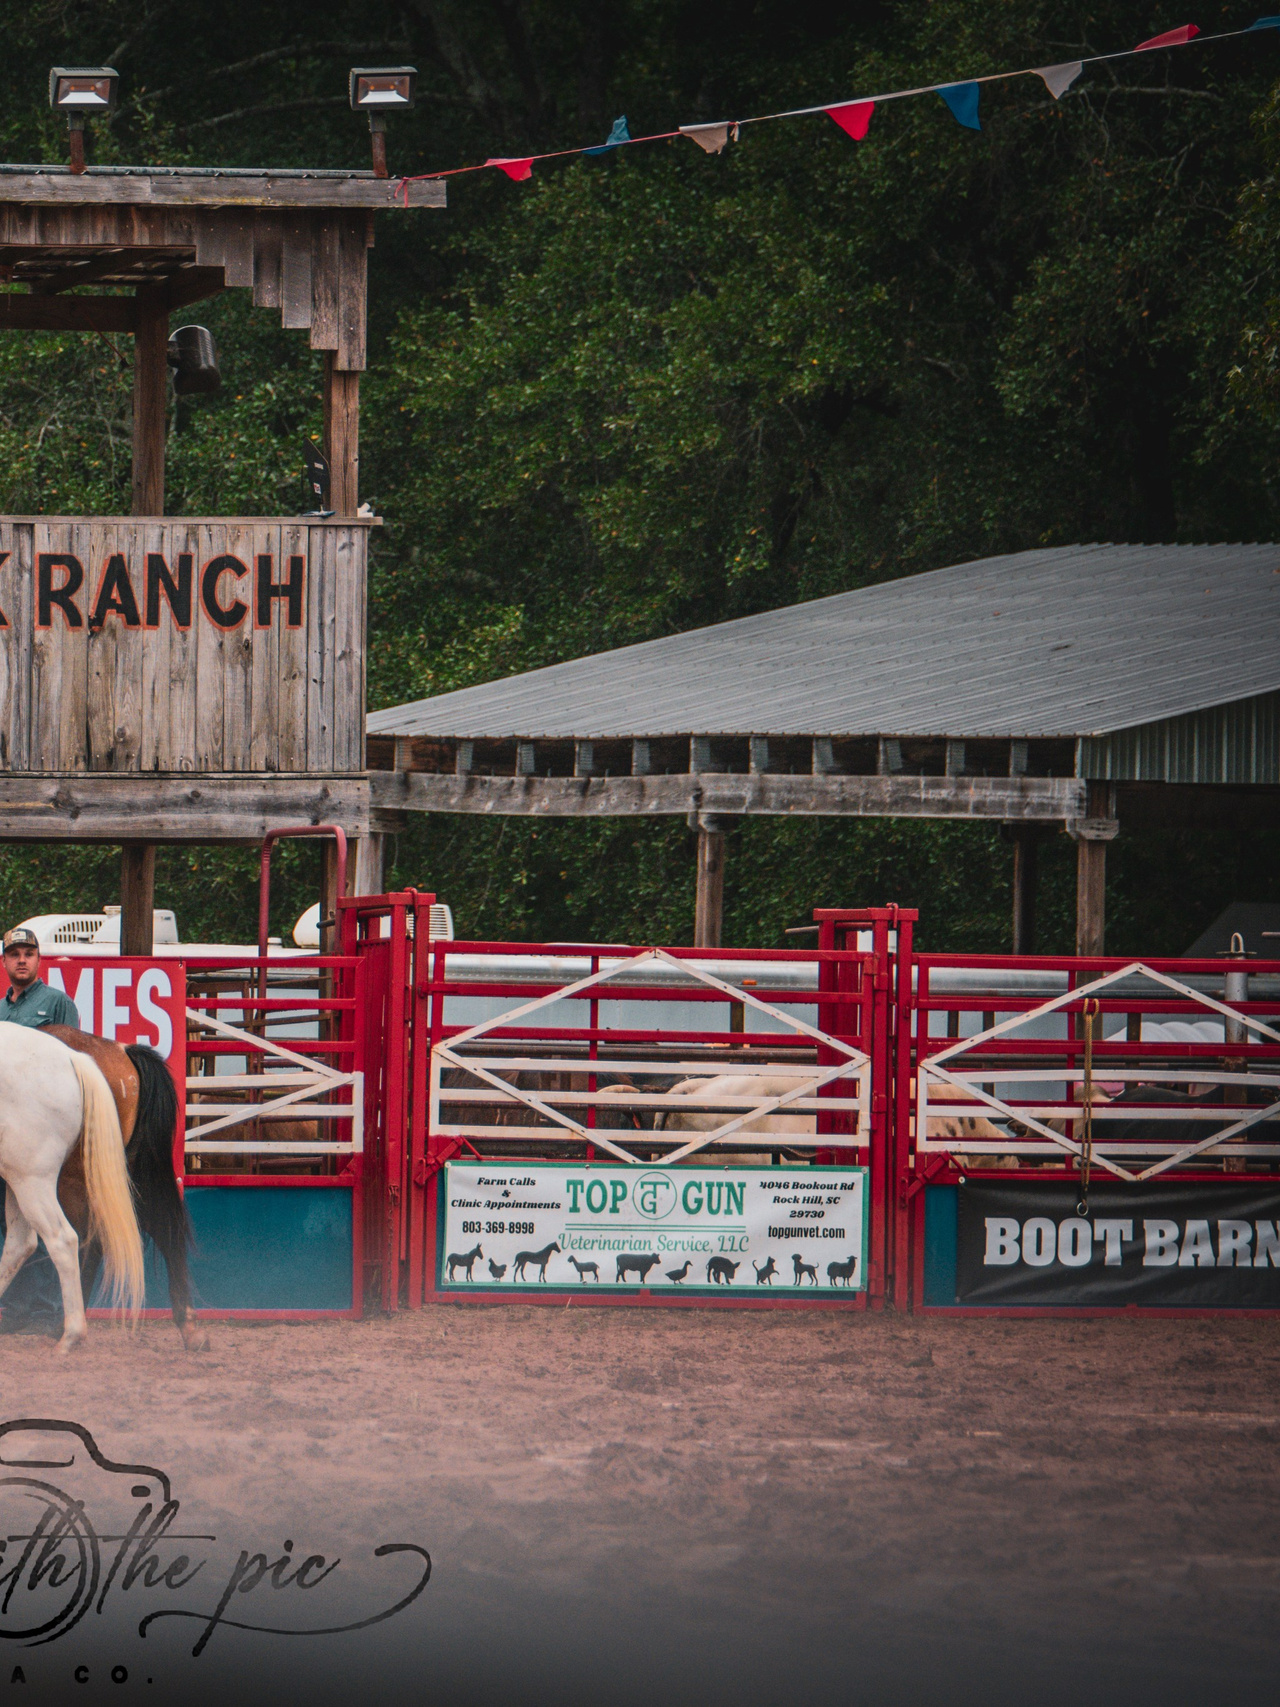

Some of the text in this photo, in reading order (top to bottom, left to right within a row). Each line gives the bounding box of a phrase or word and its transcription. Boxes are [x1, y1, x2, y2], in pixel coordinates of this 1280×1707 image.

[34, 551, 307, 633] RANCH
[477, 1177, 536, 1186] Farm Calls
[760, 1181, 855, 1190] 4046 Bookout Rd
[501, 1189, 512, 1198] &
[566, 1179, 747, 1216] TOP GUN
[451, 1199, 561, 1210] Clinic Appointments
[772, 1195, 841, 1205] Rock Hill, SC
[789, 1210, 825, 1218] 29730
[462, 1220, 535, 1234] 803-369-8998
[768, 1225, 845, 1239] topgunvet.com
[558, 1233, 750, 1253] Veterinarian Service, LLC
[983, 1217, 1280, 1267] BOOT BARN
